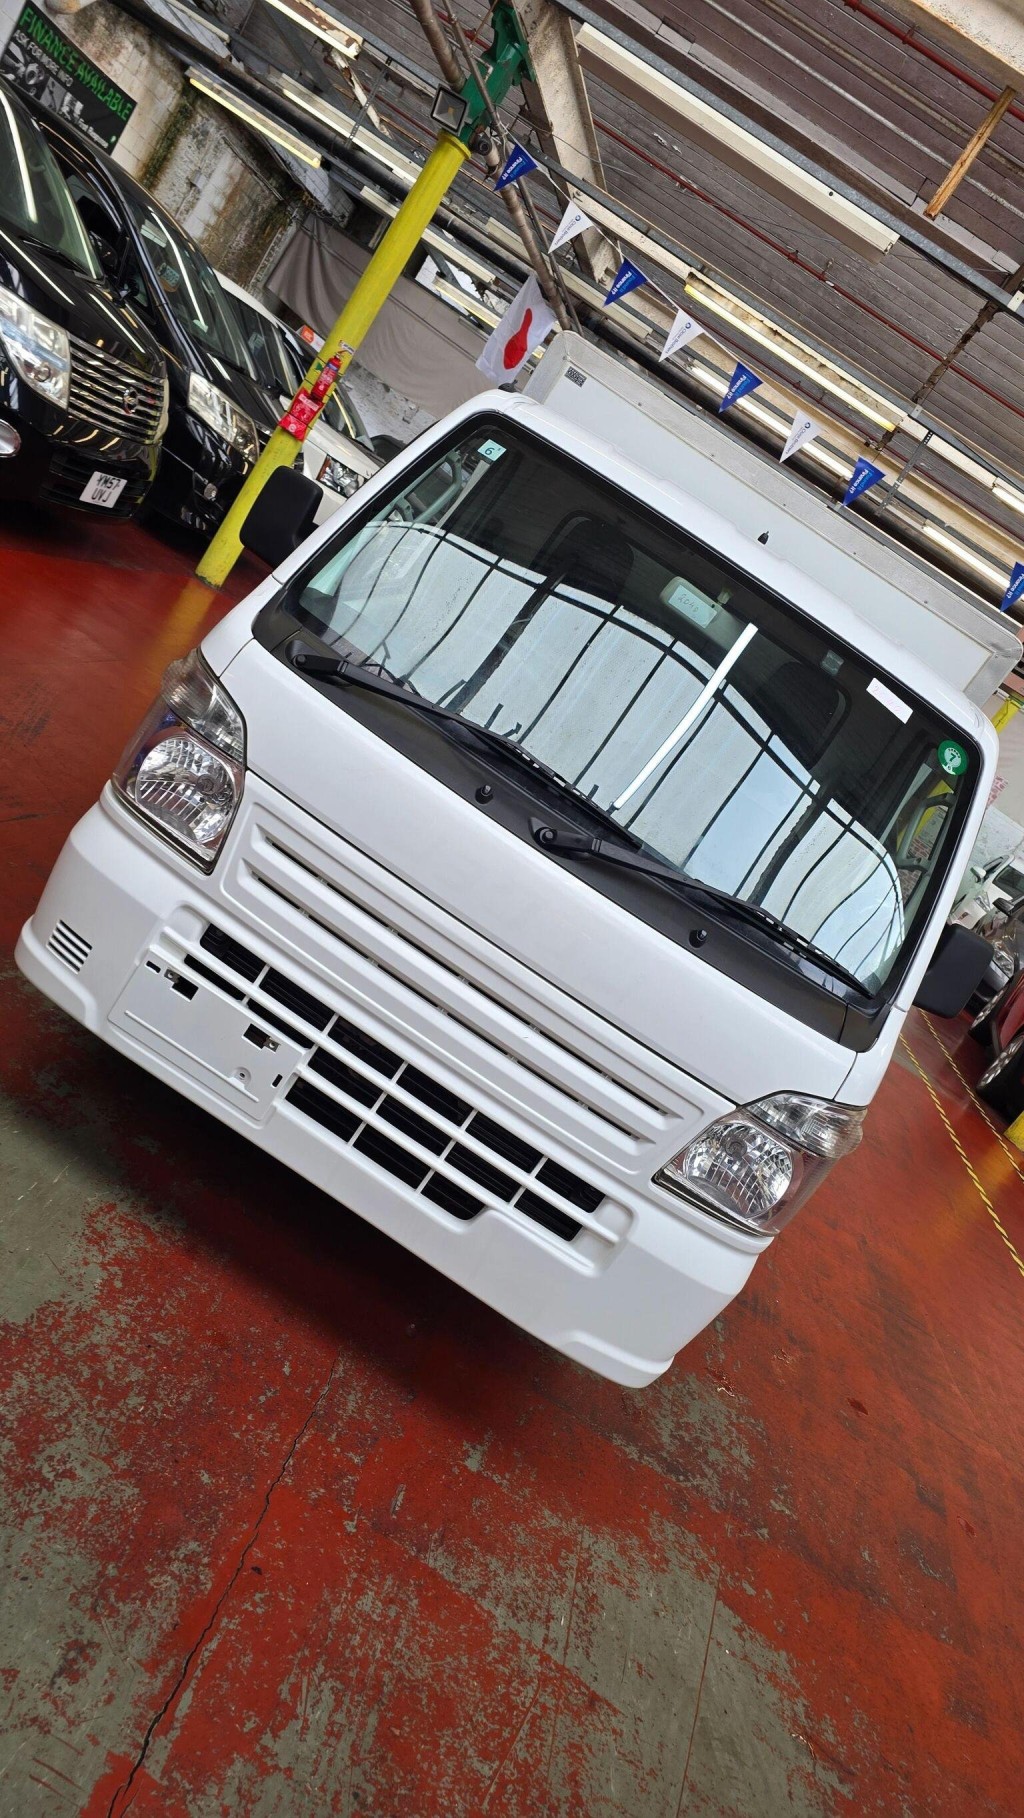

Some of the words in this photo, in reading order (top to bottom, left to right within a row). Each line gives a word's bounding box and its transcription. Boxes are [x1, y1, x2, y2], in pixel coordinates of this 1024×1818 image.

[20, 7, 79, 72] FINANCE
[74, 61, 134, 121] AVAILABLE
[484, 445, 495, 456] 6
[96, 473, 121, 490] YM57
[91, 487, 112, 503] UVJ
[949, 752, 957, 763] 7
